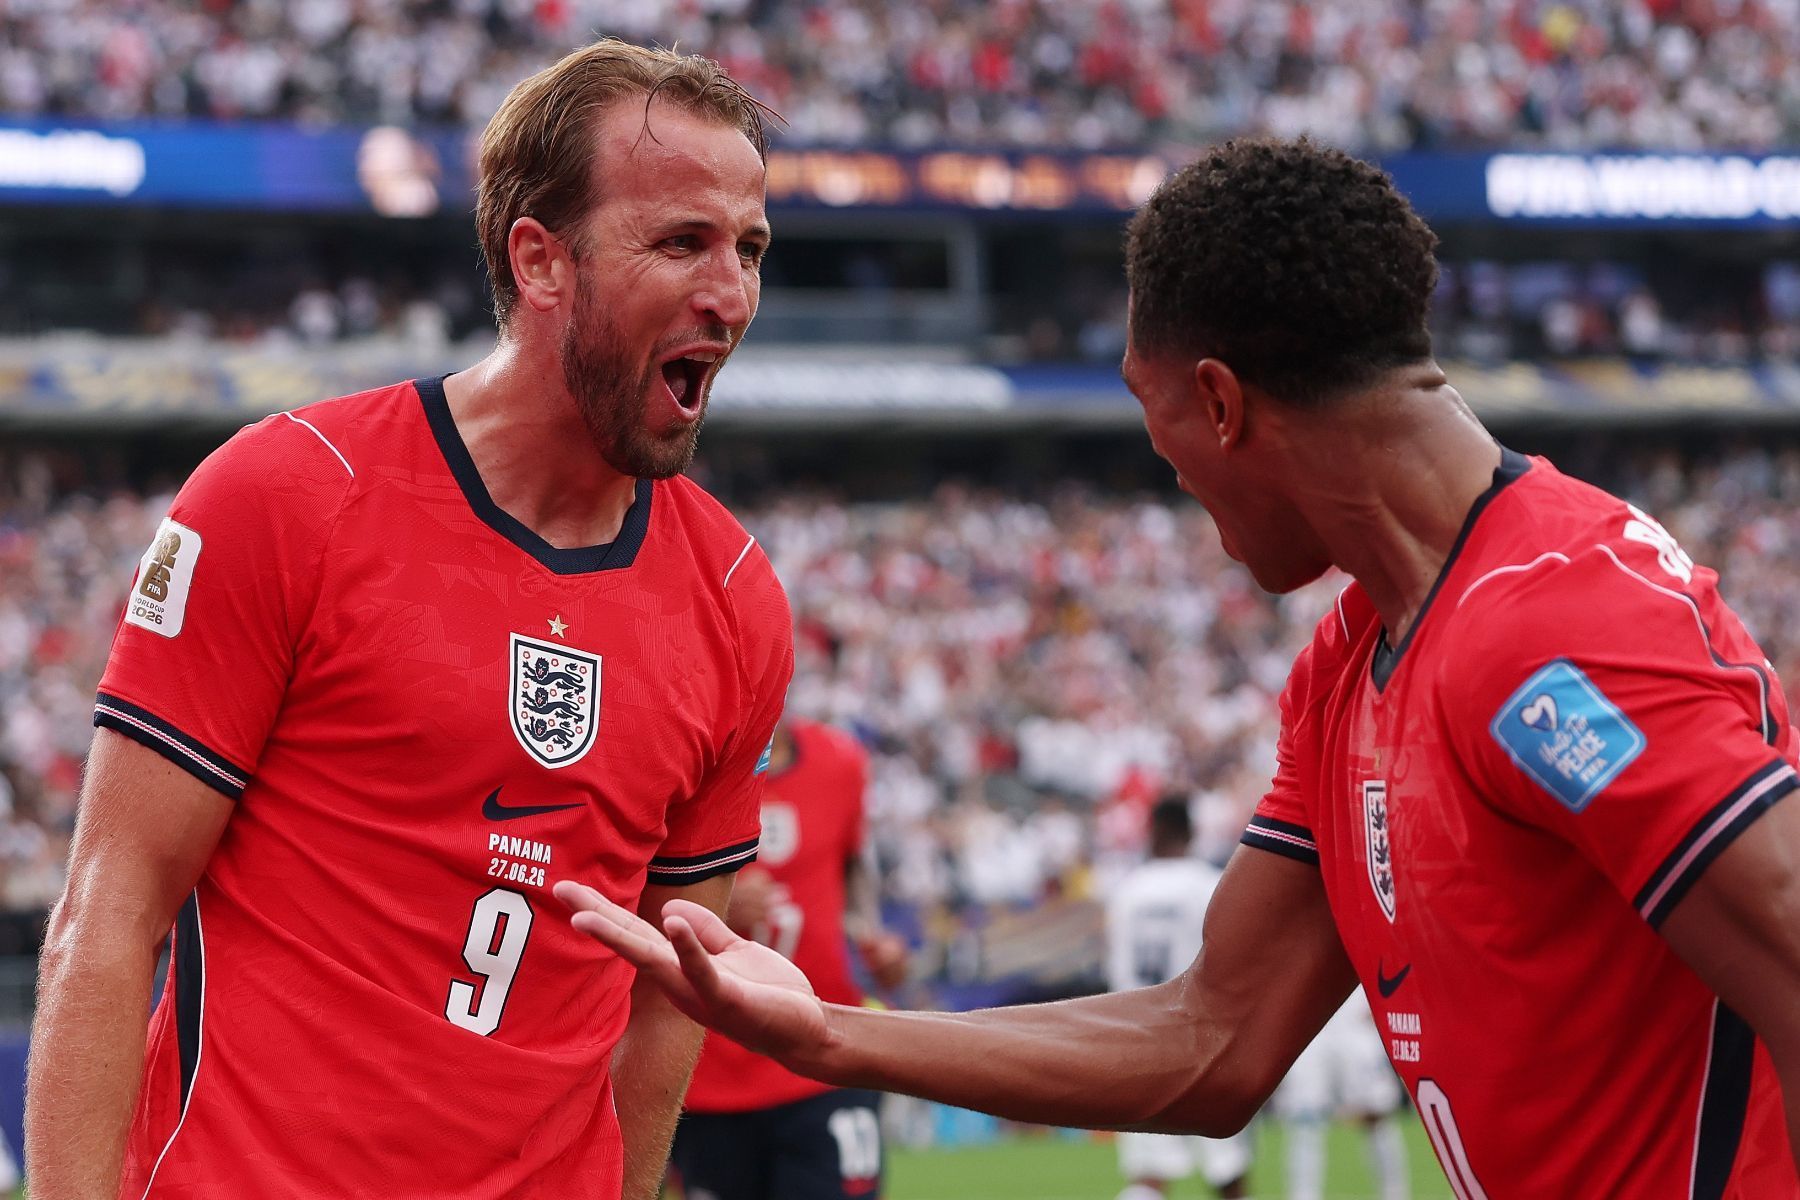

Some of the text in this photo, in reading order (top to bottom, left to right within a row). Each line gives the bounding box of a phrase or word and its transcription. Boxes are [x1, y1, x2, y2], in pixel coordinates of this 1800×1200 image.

[134, 596, 166, 614] ORLD CUP
[146, 582, 162, 597] FIFA
[131, 604, 164, 625] 2026
[1555, 728, 1608, 780] PEACE
[488, 833, 552, 865] PANAMA
[487, 857, 545, 888] 27.06.26
[444, 887, 536, 1037] 9
